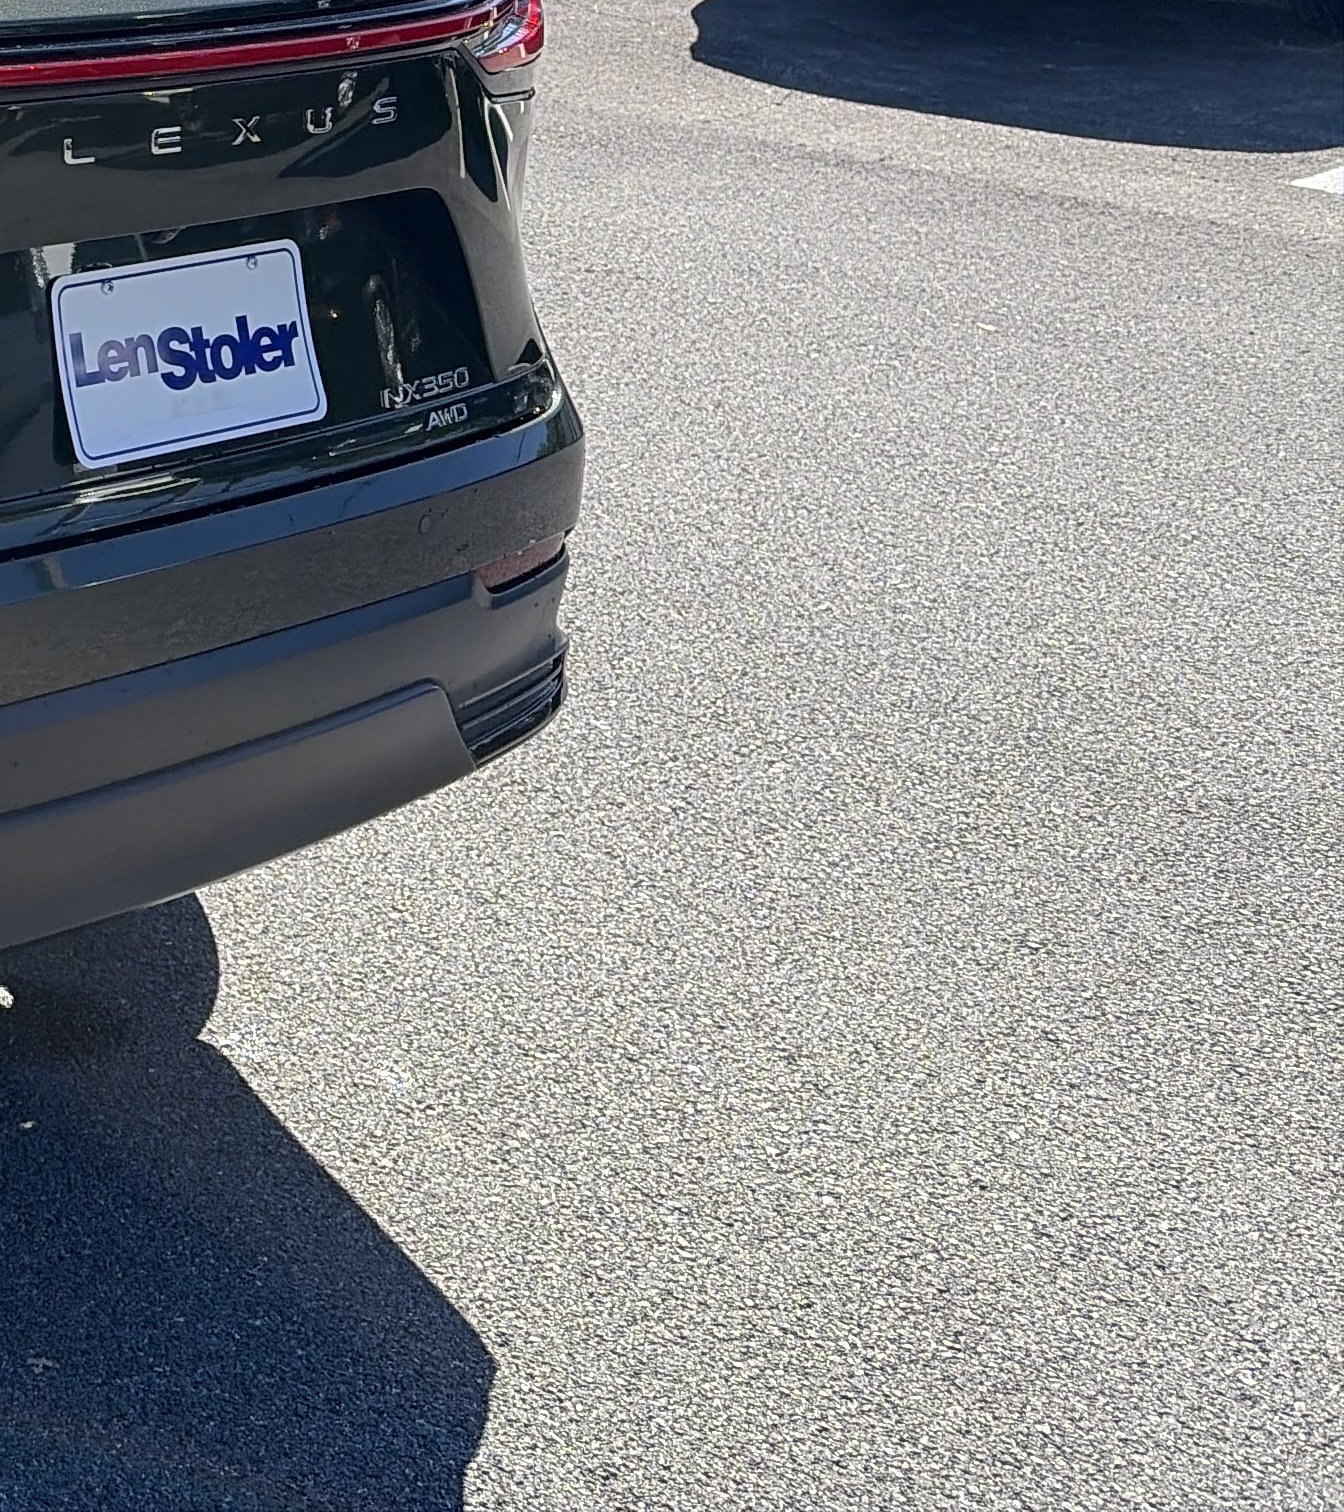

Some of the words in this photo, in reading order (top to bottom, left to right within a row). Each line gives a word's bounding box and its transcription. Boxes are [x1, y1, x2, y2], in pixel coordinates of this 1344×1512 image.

[64, 86, 398, 165] LEXUS
[69, 315, 300, 391] LenStoler
[426, 403, 468, 432] AWD
